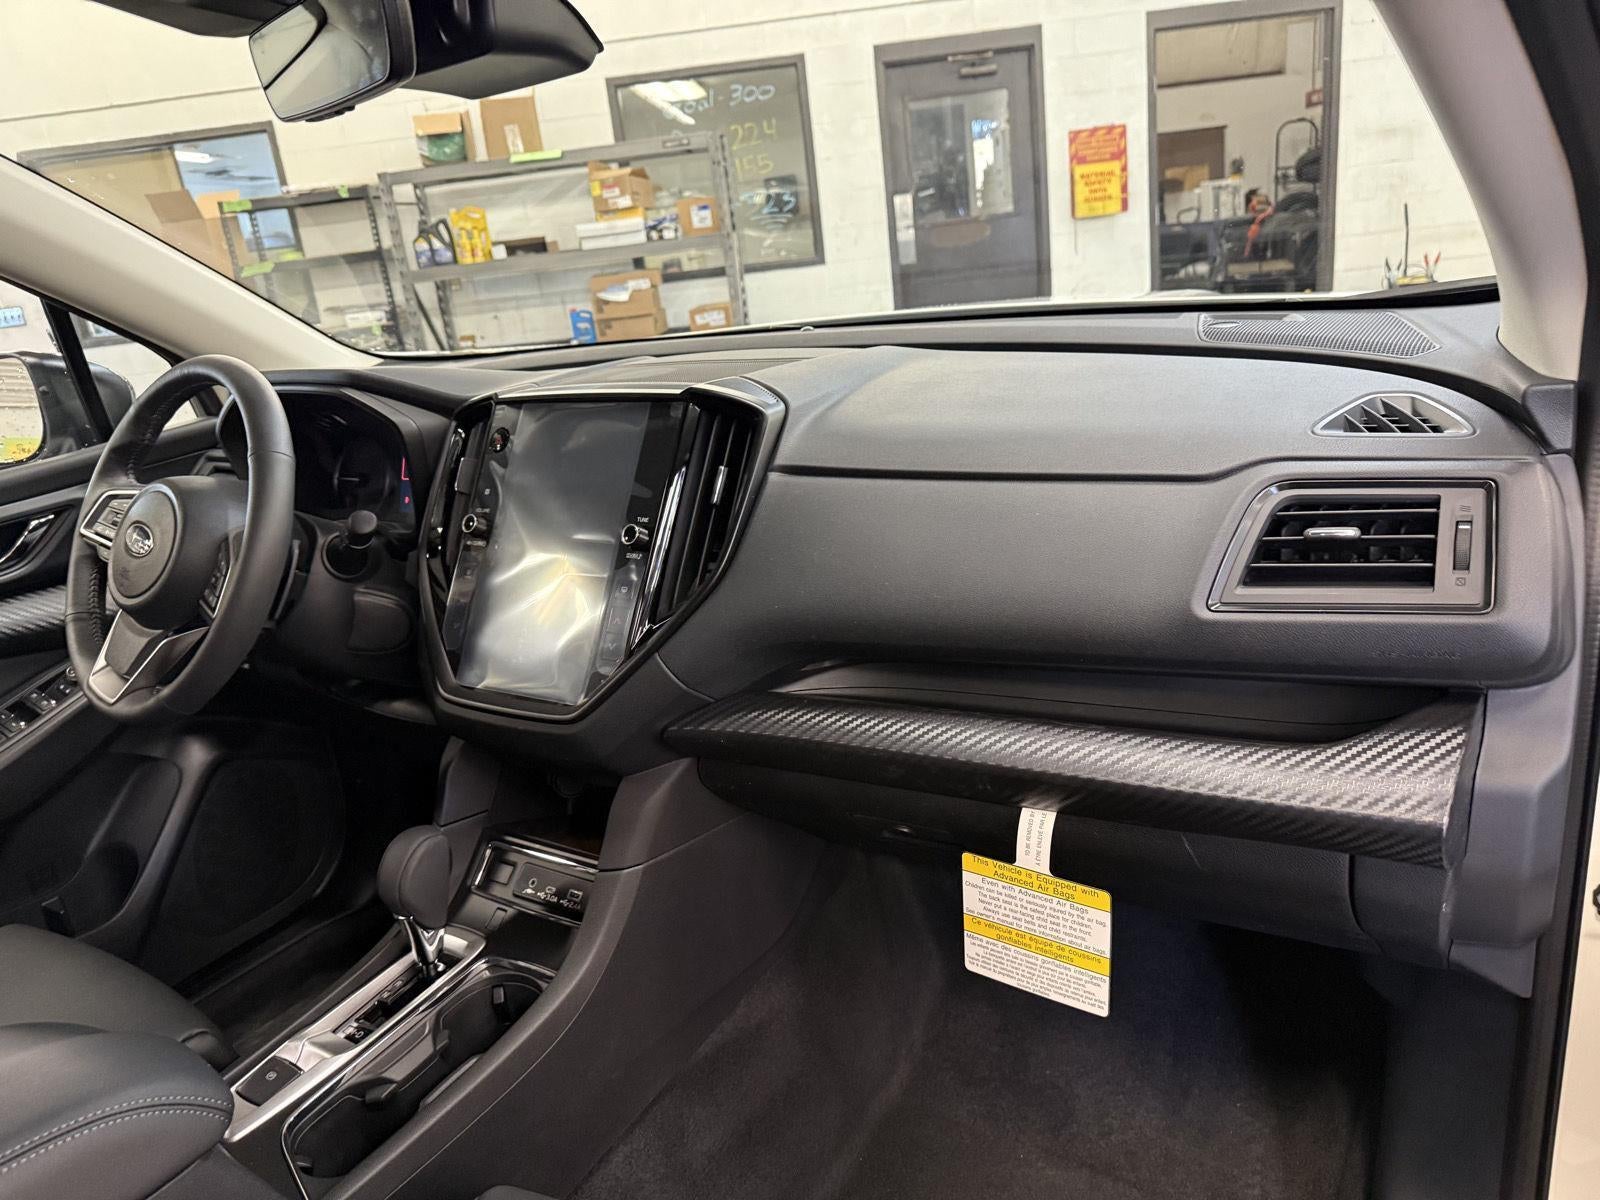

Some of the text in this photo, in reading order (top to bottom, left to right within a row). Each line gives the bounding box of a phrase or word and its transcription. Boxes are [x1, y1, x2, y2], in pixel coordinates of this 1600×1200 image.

[729, 83, 776, 106] 300
[729, 117, 777, 151] 224
[964, 880, 984, 890] Children
[972, 855, 1098, 898] This Vehicle is Equipped with
[993, 870, 1074, 901] Advanced Air Bags
[981, 877, 1088, 915] Even with Advanced Air Bags
[971, 916, 981, 926] Ce
[984, 920, 1012, 935] véhicule
[1015, 930, 1025, 940] est
[1056, 943, 1065, 952] de
[1068, 946, 1101, 963] coussins
[995, 932, 1073, 963] gonflables intelligents
